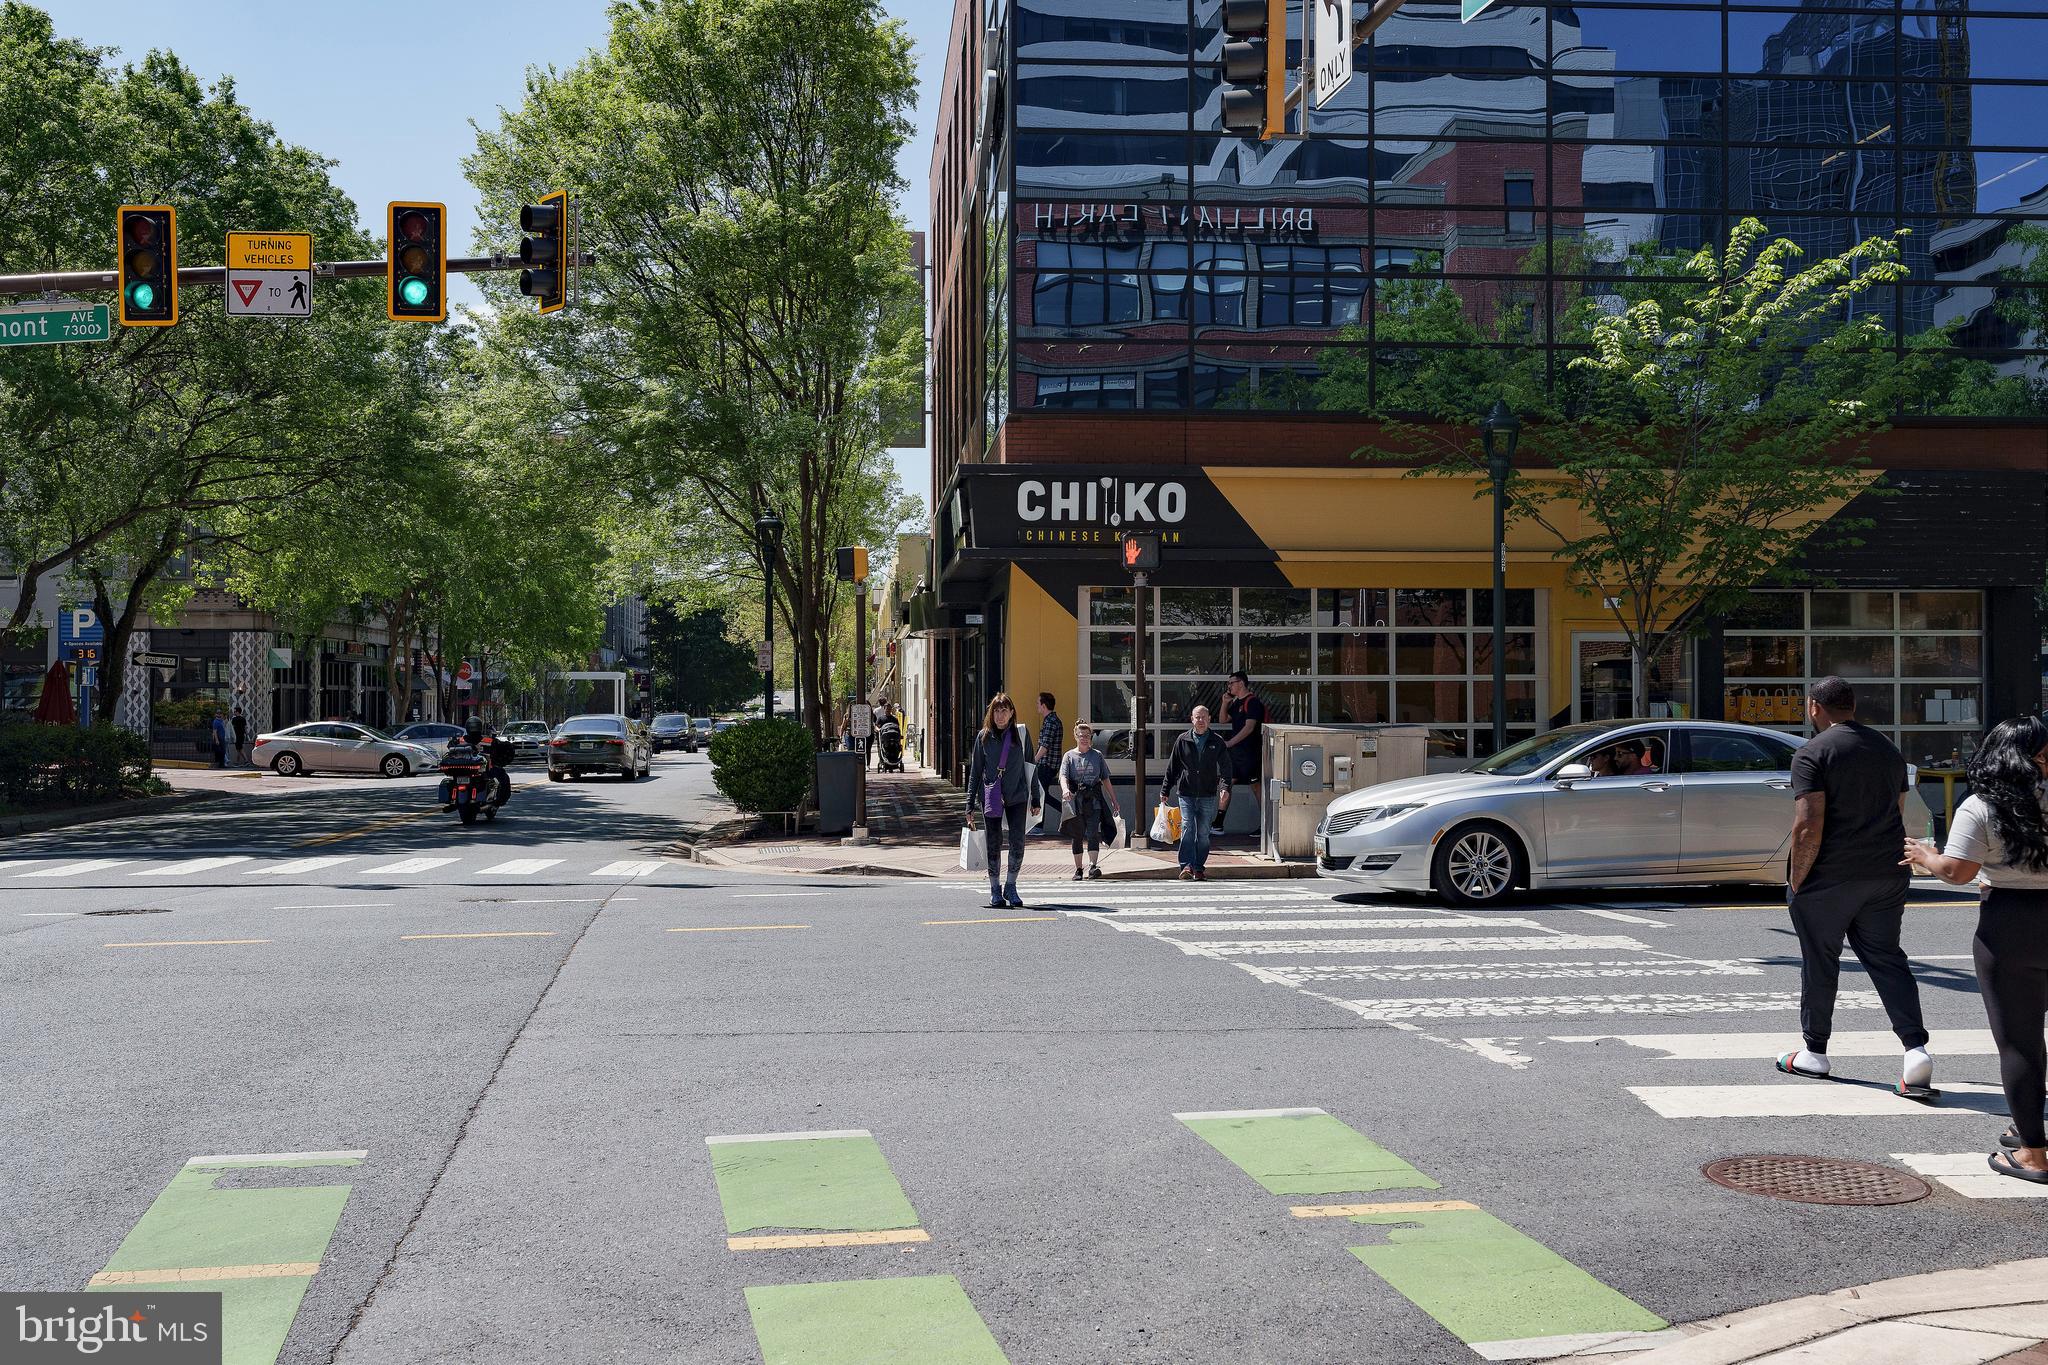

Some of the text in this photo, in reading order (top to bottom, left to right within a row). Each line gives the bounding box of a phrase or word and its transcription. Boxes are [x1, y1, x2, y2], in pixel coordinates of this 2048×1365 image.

[1320, 48, 1346, 91] ONLY
[248, 240, 292, 251] TURNING
[244, 254, 294, 265] VEHICLES
[268, 287, 281, 297] TO
[70, 312, 94, 323] AVE
[63, 324, 95, 336] 7300
[1017, 480, 1187, 523] CHIKO
[1026, 530, 1179, 543] CHINESE KAN
[72, 608, 96, 638] P
